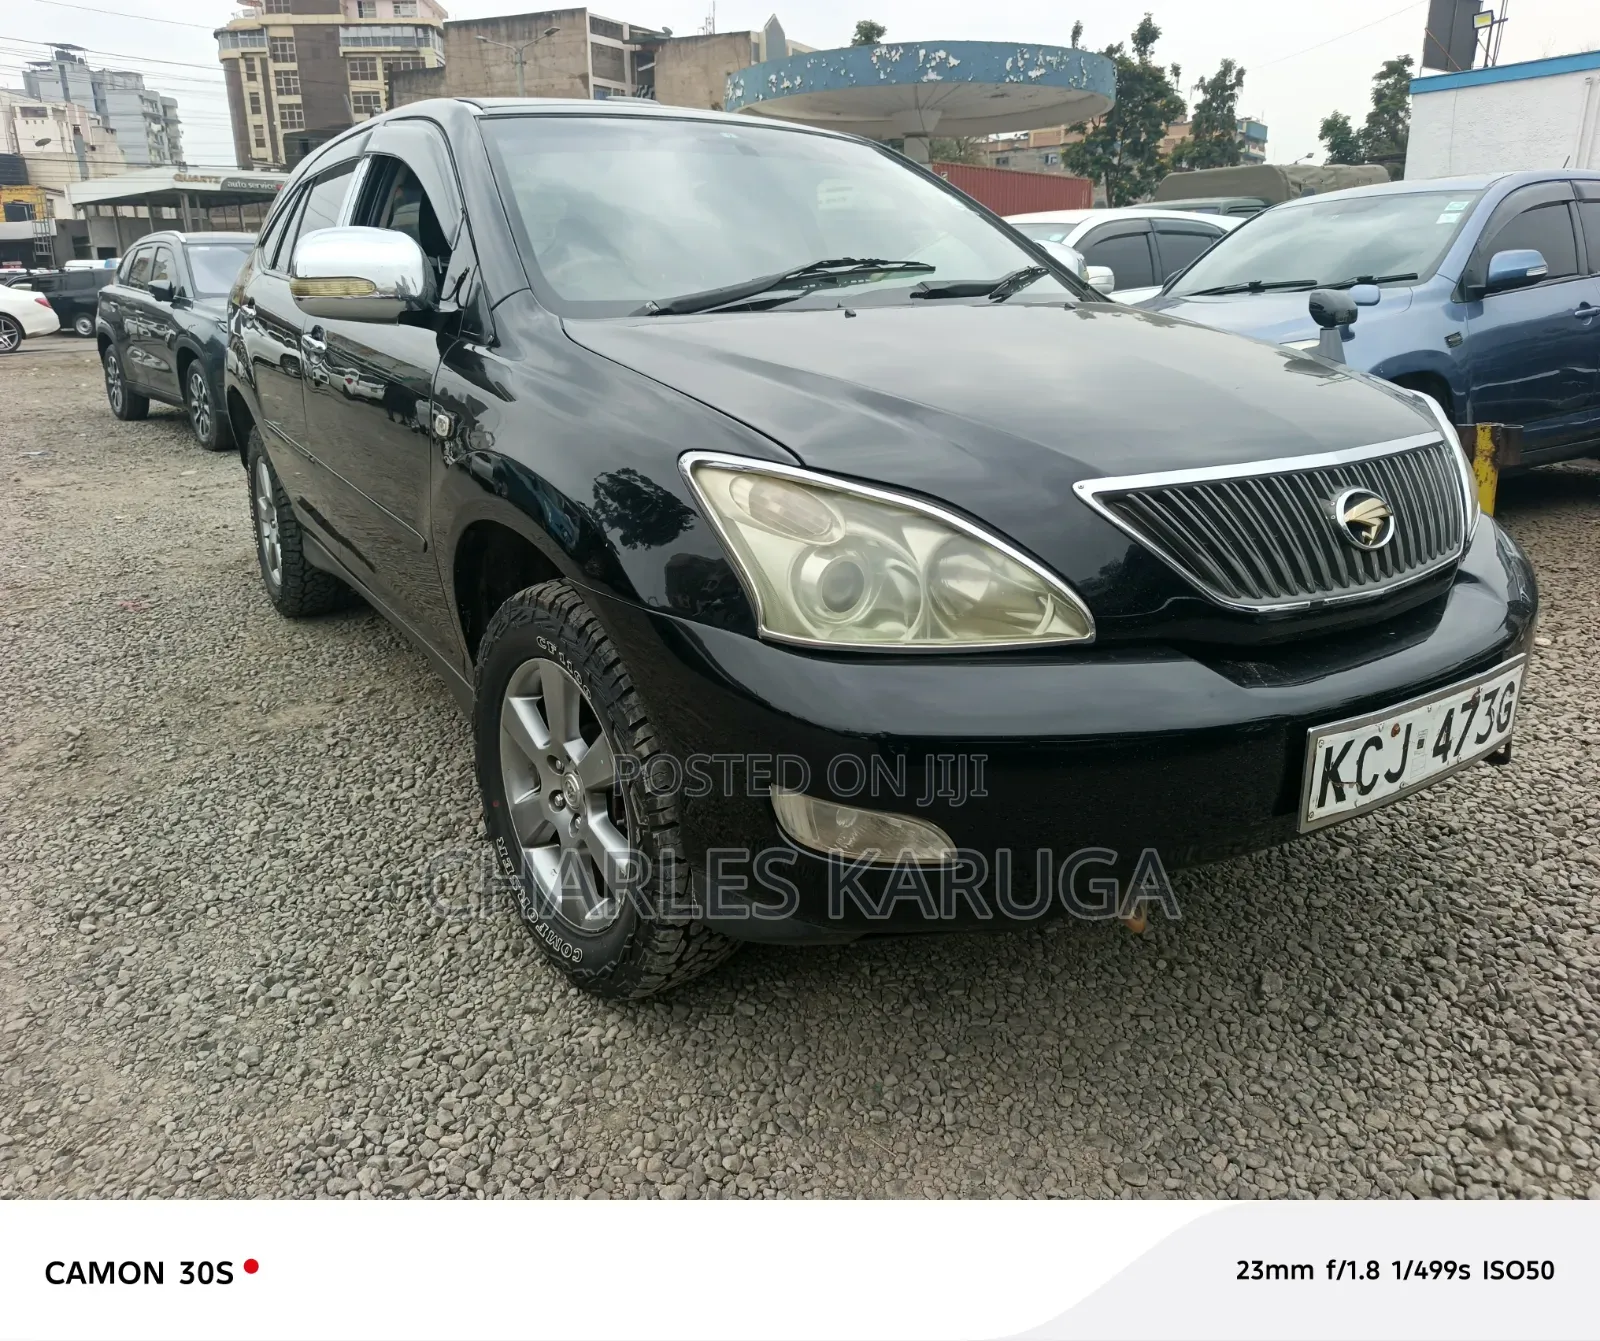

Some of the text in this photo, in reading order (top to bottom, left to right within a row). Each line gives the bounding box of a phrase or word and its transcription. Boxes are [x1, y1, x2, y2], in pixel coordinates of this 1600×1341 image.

[227, 180, 276, 190] auto service
[496, 836, 583, 963] COMFORSER
